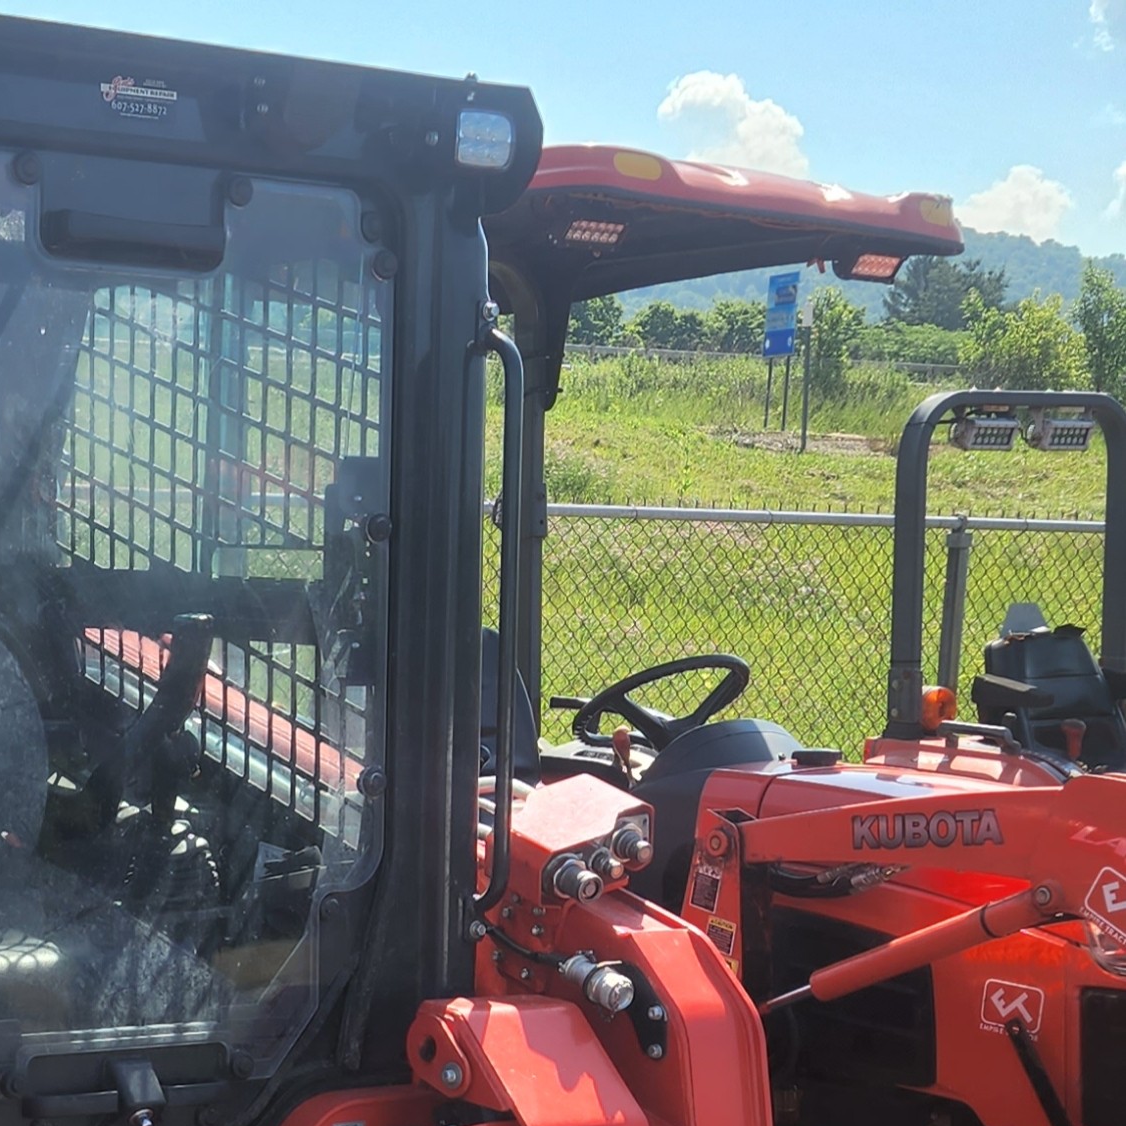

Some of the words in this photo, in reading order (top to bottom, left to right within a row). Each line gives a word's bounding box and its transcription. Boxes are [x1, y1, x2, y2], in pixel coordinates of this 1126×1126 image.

[851, 808, 1005, 850] KUBOTA
[1079, 906, 1105, 928] EMPIRE
[979, 1023, 1004, 1035] EMPIRE
